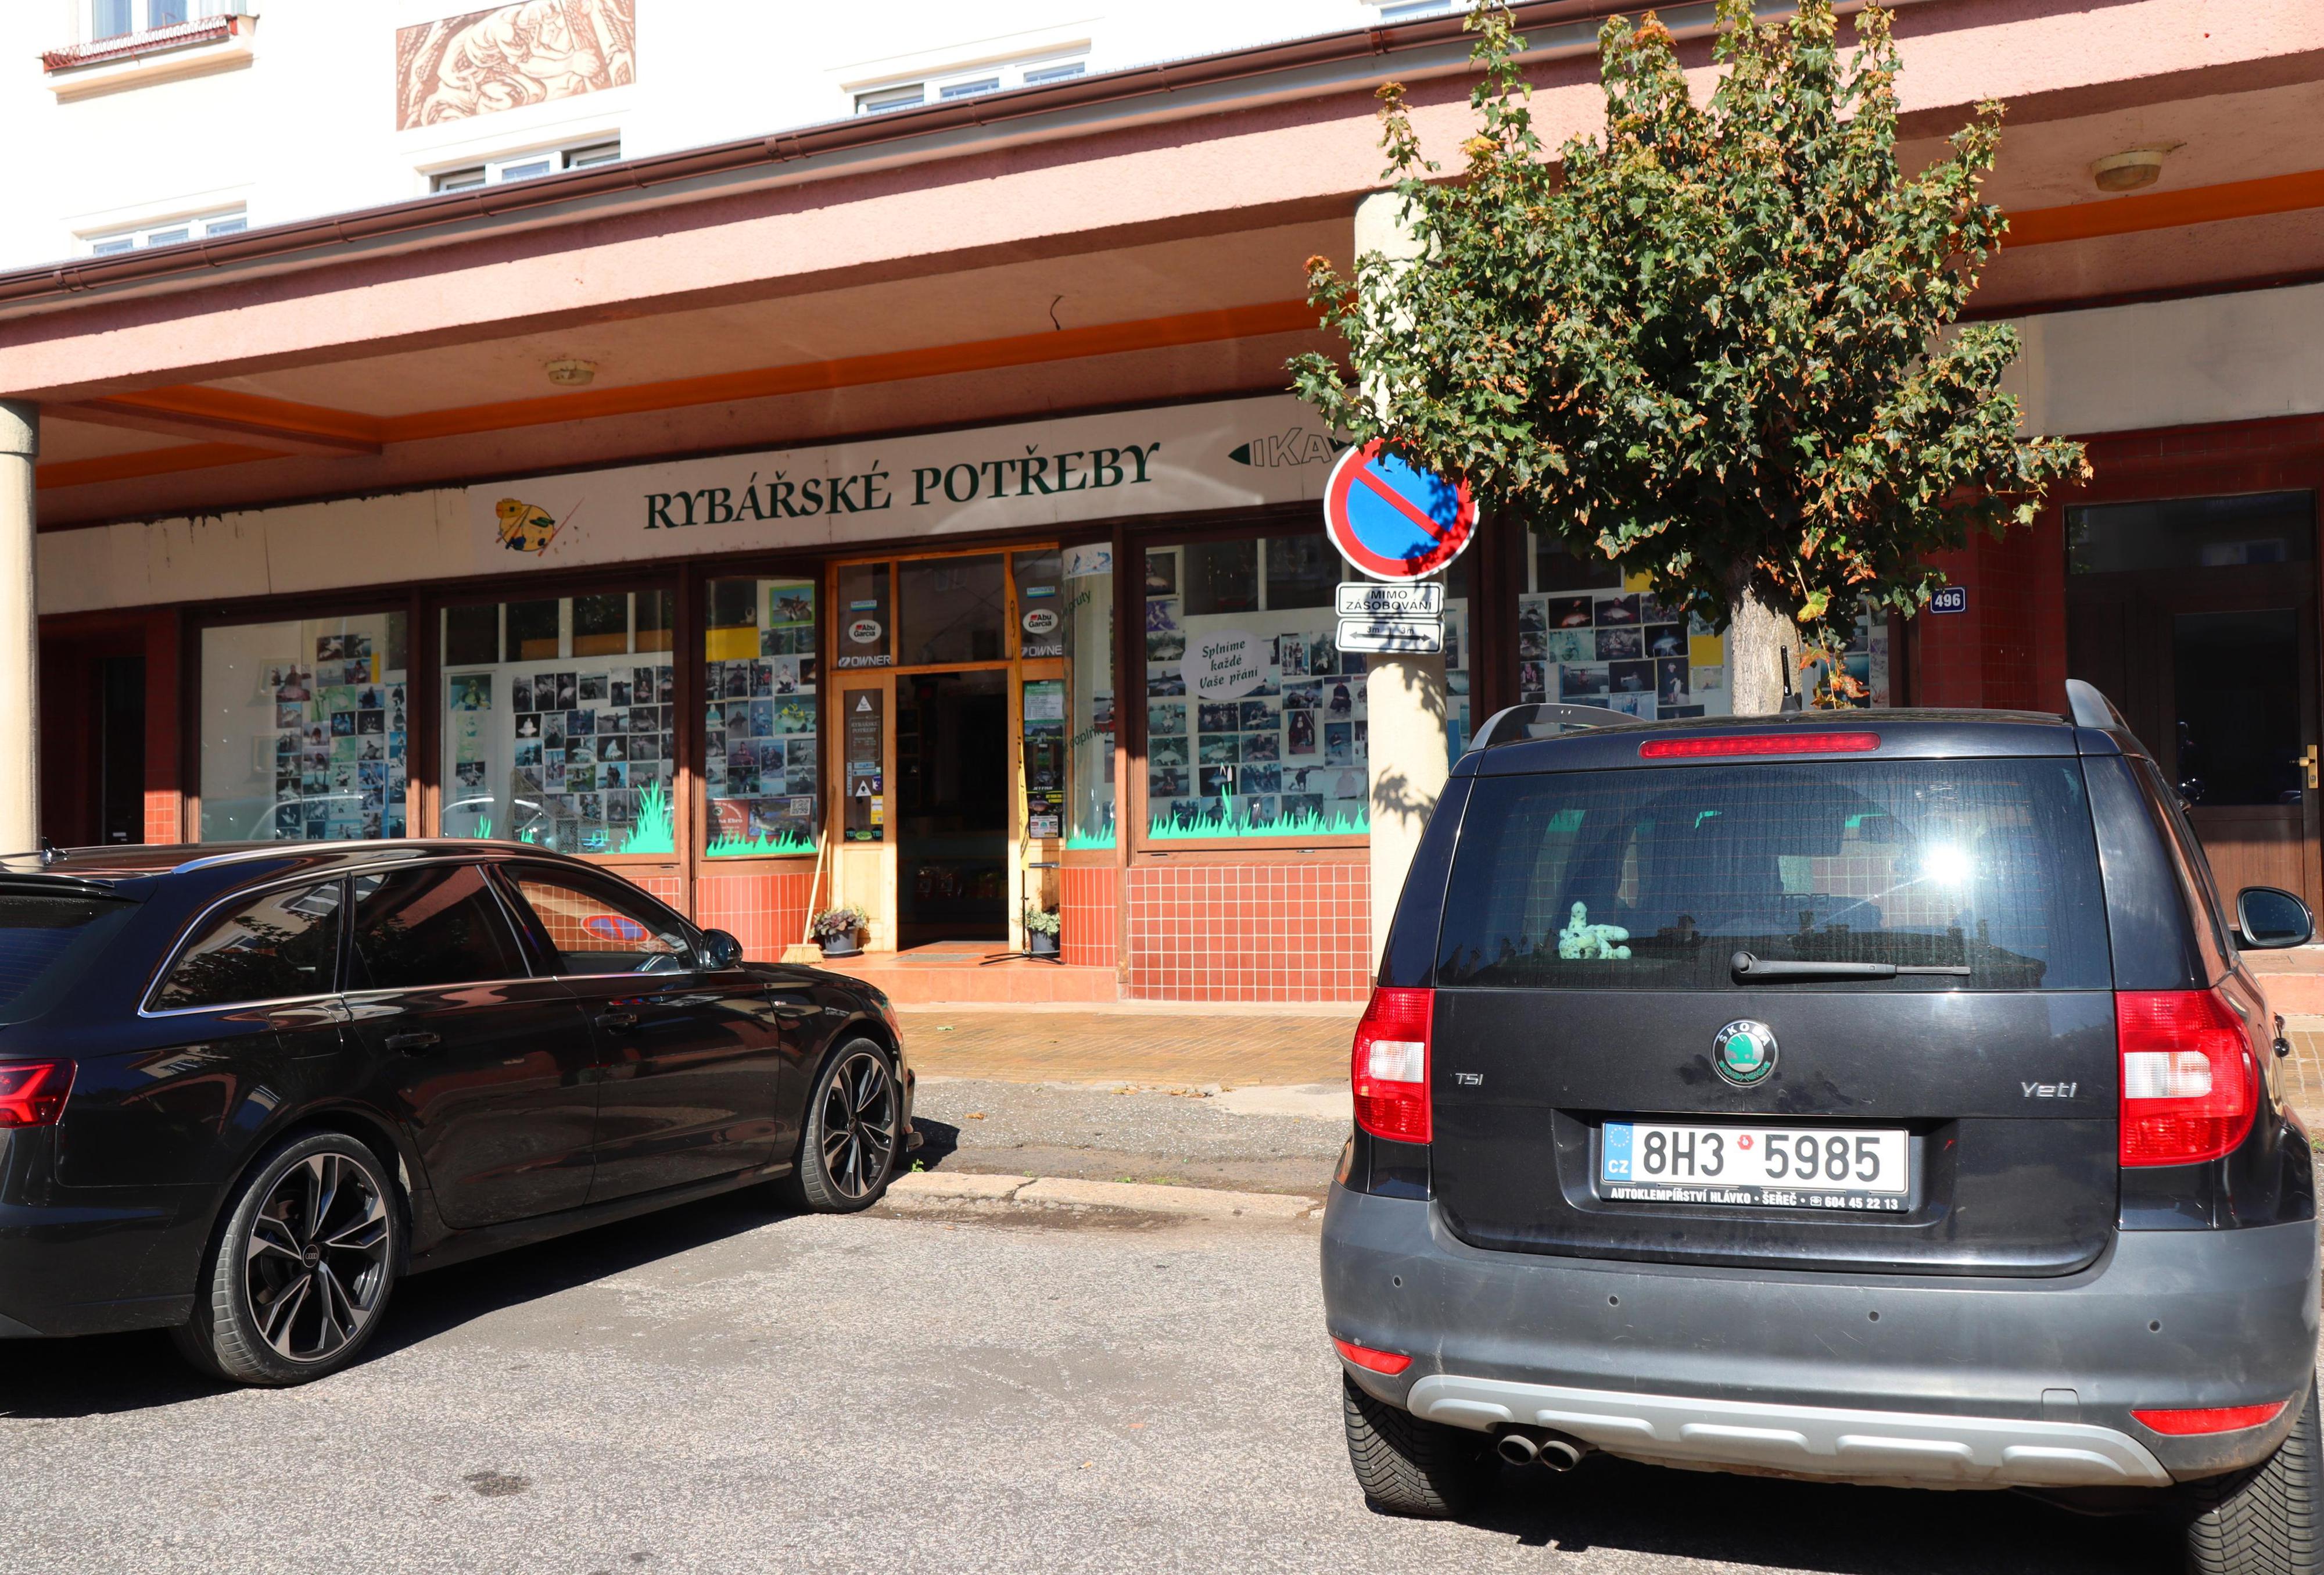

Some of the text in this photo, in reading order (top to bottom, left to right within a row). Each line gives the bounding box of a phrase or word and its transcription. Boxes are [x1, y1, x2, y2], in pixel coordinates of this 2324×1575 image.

[1253, 427, 1332, 467] IKA
[643, 442, 1161, 529] RYBÁŘSKÉ POTŘEBY
[1371, 590, 1407, 599] MIMO
[1935, 593, 1961, 607] 496
[1346, 598, 1432, 610] ZÁSOBOVÁNÍ
[1028, 645, 1062, 657] OWNE
[851, 655, 891, 667] OWNER
[1211, 654, 1242, 671] každé
[1200, 665, 1258, 689] Vaše přání
[1455, 1073, 1483, 1086] TSI
[2021, 1082, 2077, 1098] Yeti
[1643, 1132, 1881, 1182] 8H3 5985
[1608, 1159, 1629, 1174] CZ
[1611, 1187, 1898, 1210] AUTOKLEMPÍŘSTVÍ HLÁVKO ŠEŘEČ 604 45 22 13
